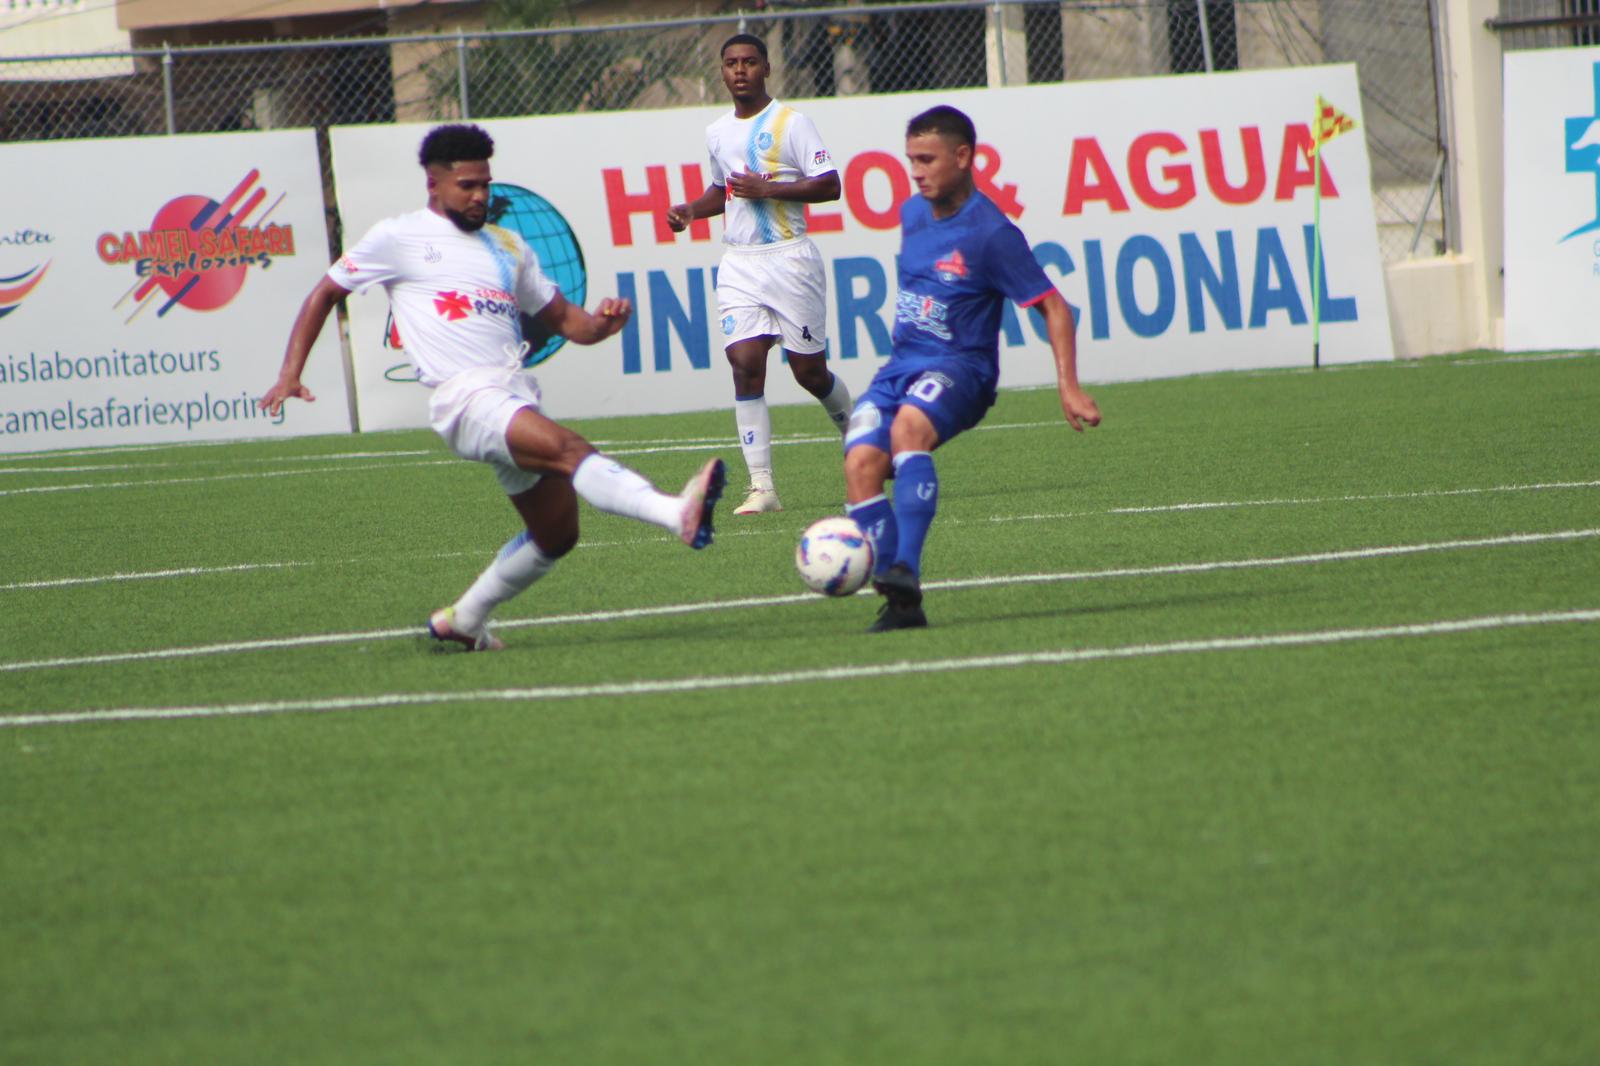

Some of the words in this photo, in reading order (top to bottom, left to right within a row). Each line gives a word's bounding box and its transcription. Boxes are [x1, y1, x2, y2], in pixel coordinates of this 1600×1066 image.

[602, 151, 911, 246] HIO
[1062, 122, 1340, 216] AGUA
[96, 227, 191, 265] CAMEL
[200, 222, 297, 257] SAFARI
[801, 325, 812, 342] 4
[0, 391, 286, 434] amelsafariexploring
